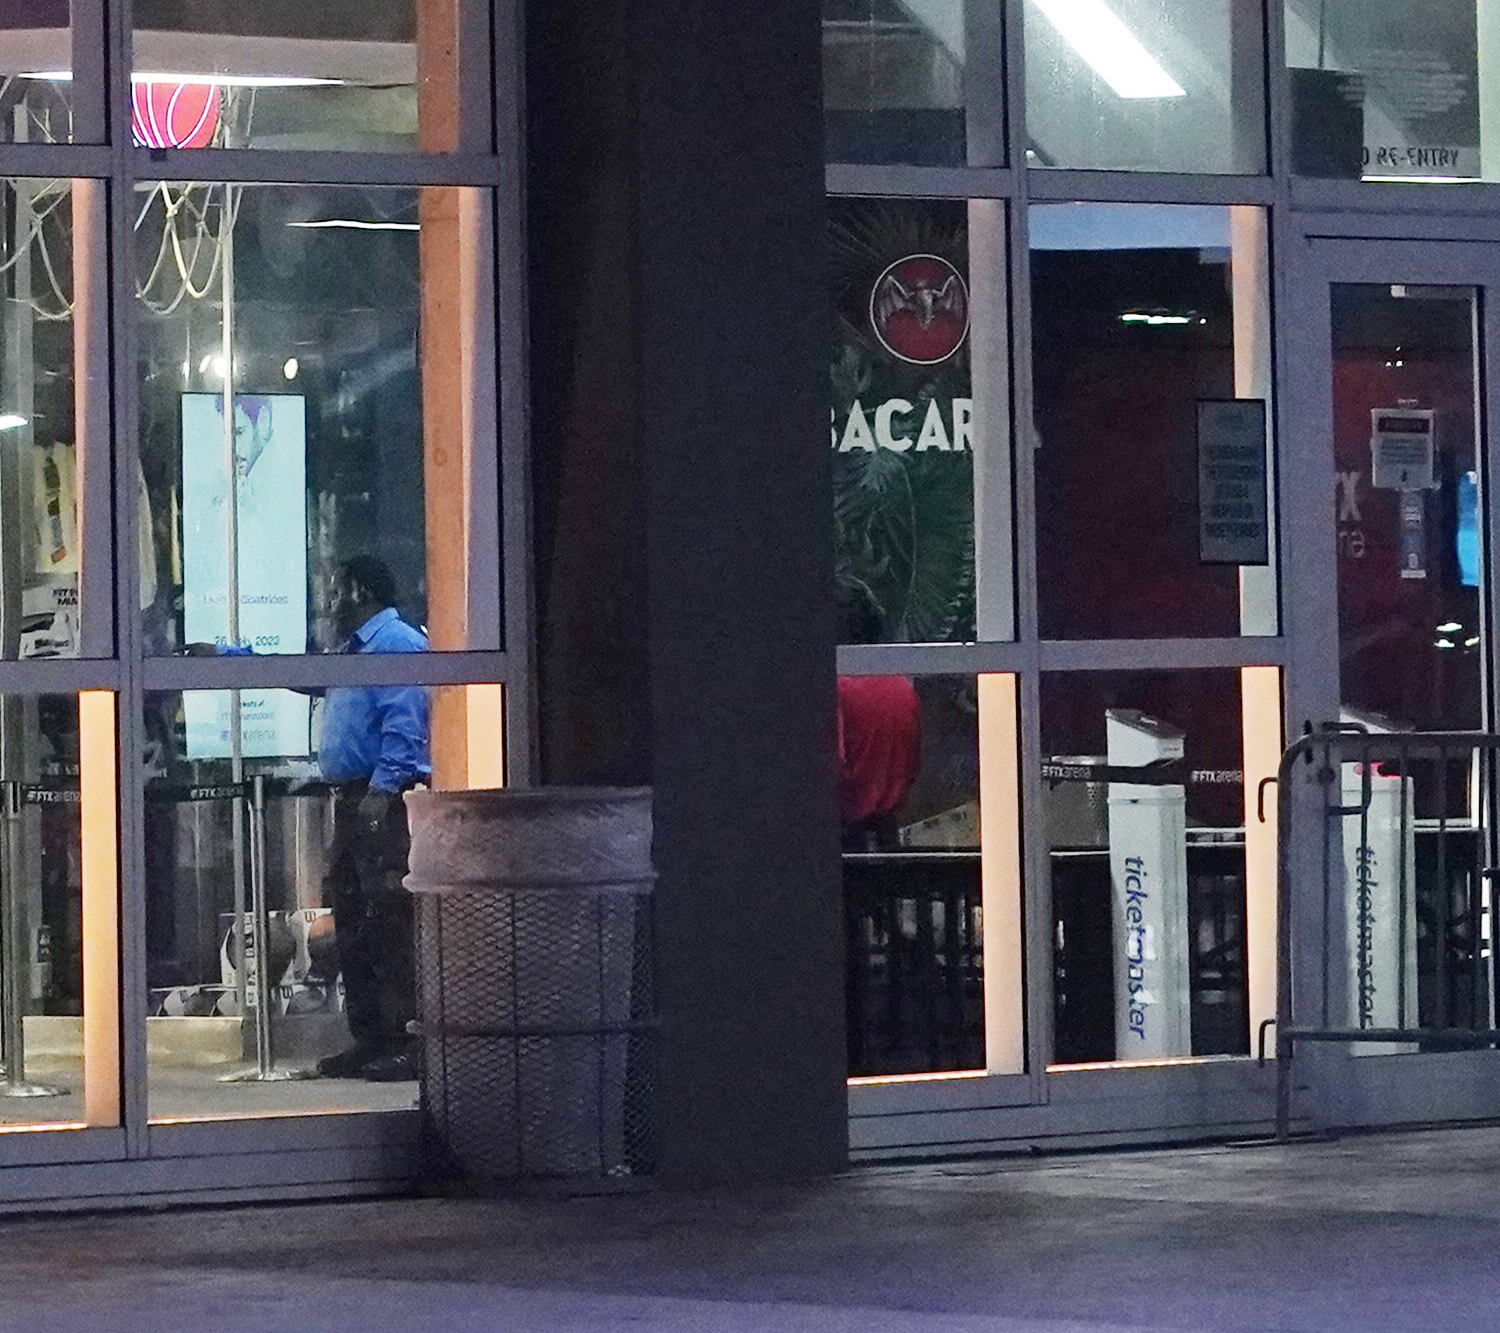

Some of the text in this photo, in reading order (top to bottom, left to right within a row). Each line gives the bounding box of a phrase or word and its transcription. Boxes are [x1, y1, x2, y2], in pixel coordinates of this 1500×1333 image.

[1376, 147, 1458, 167] RE-ENTRY
[830, 397, 974, 453] ACAR
[255, 635, 280, 646] 2023
[1124, 855, 1149, 1041] ticketmaster
